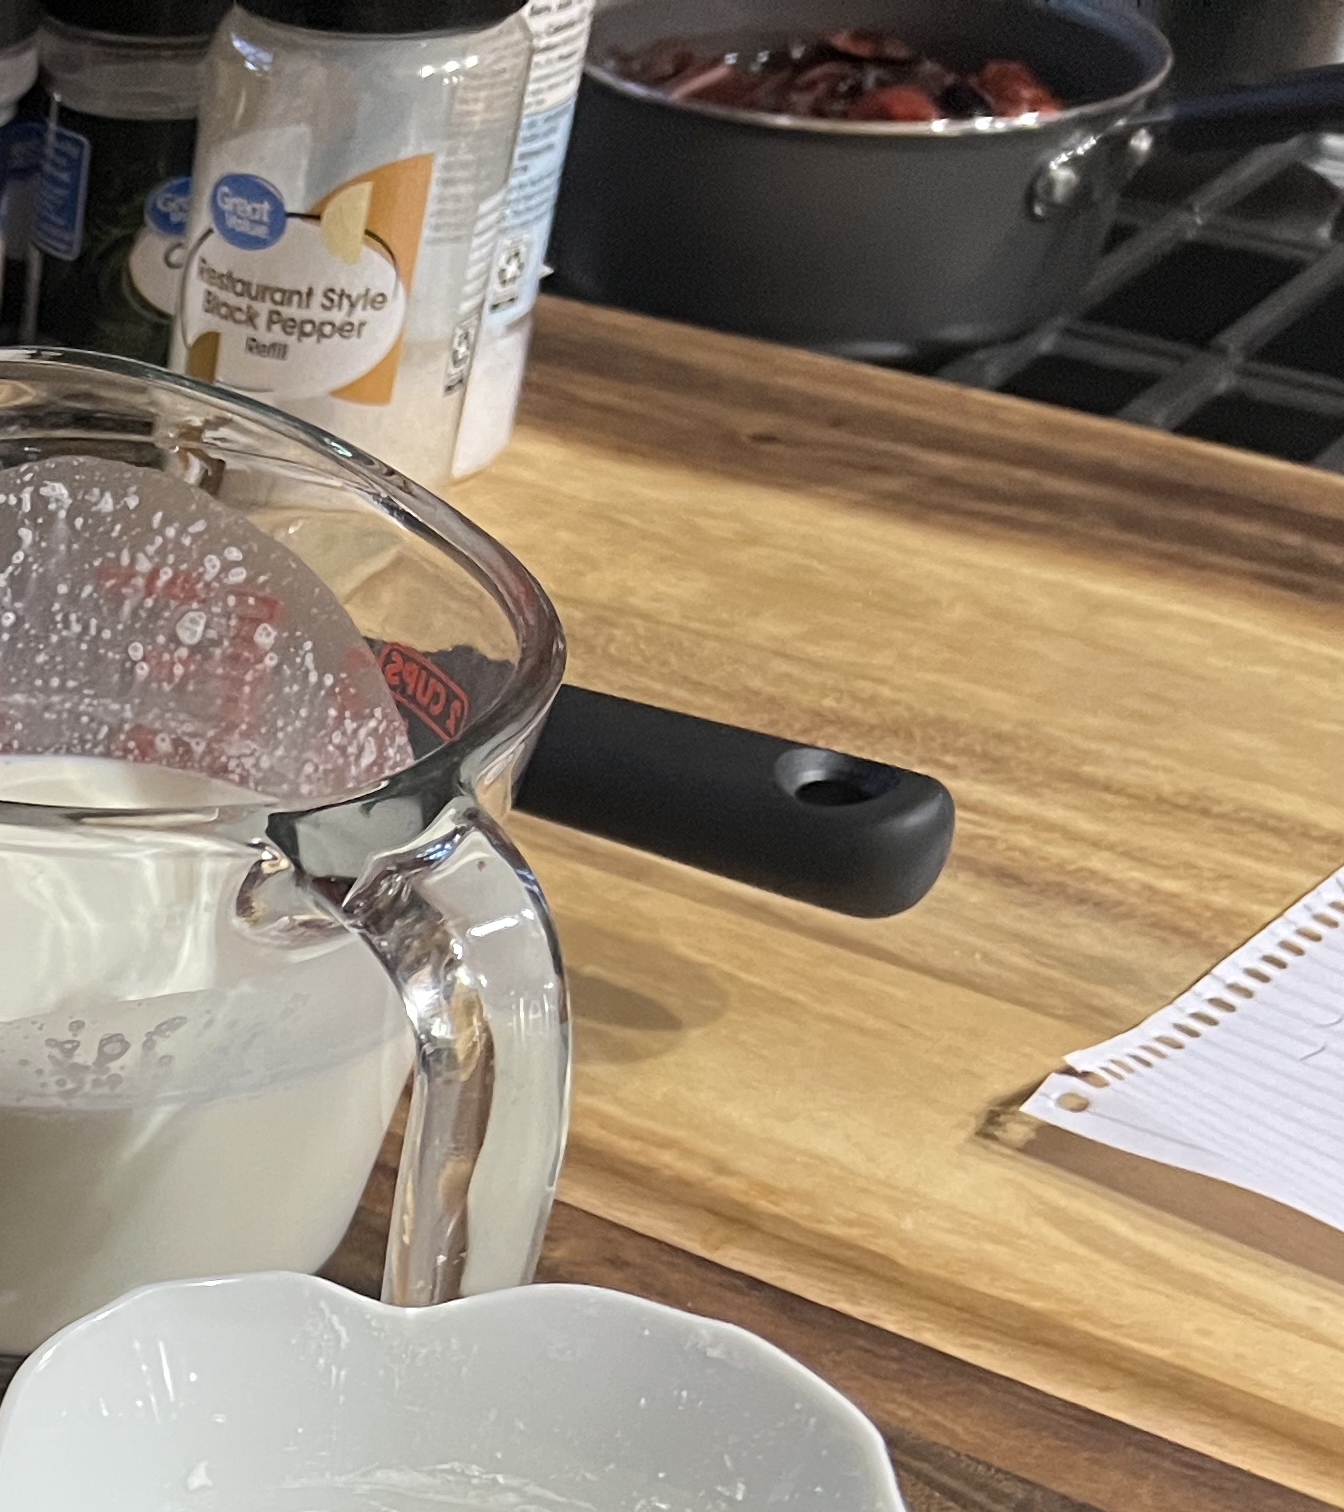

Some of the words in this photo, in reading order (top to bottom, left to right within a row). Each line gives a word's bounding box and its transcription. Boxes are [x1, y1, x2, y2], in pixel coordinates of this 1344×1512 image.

[217, 186, 271, 222] Great
[321, 287, 388, 317] Style
[267, 309, 367, 343] Pepper
